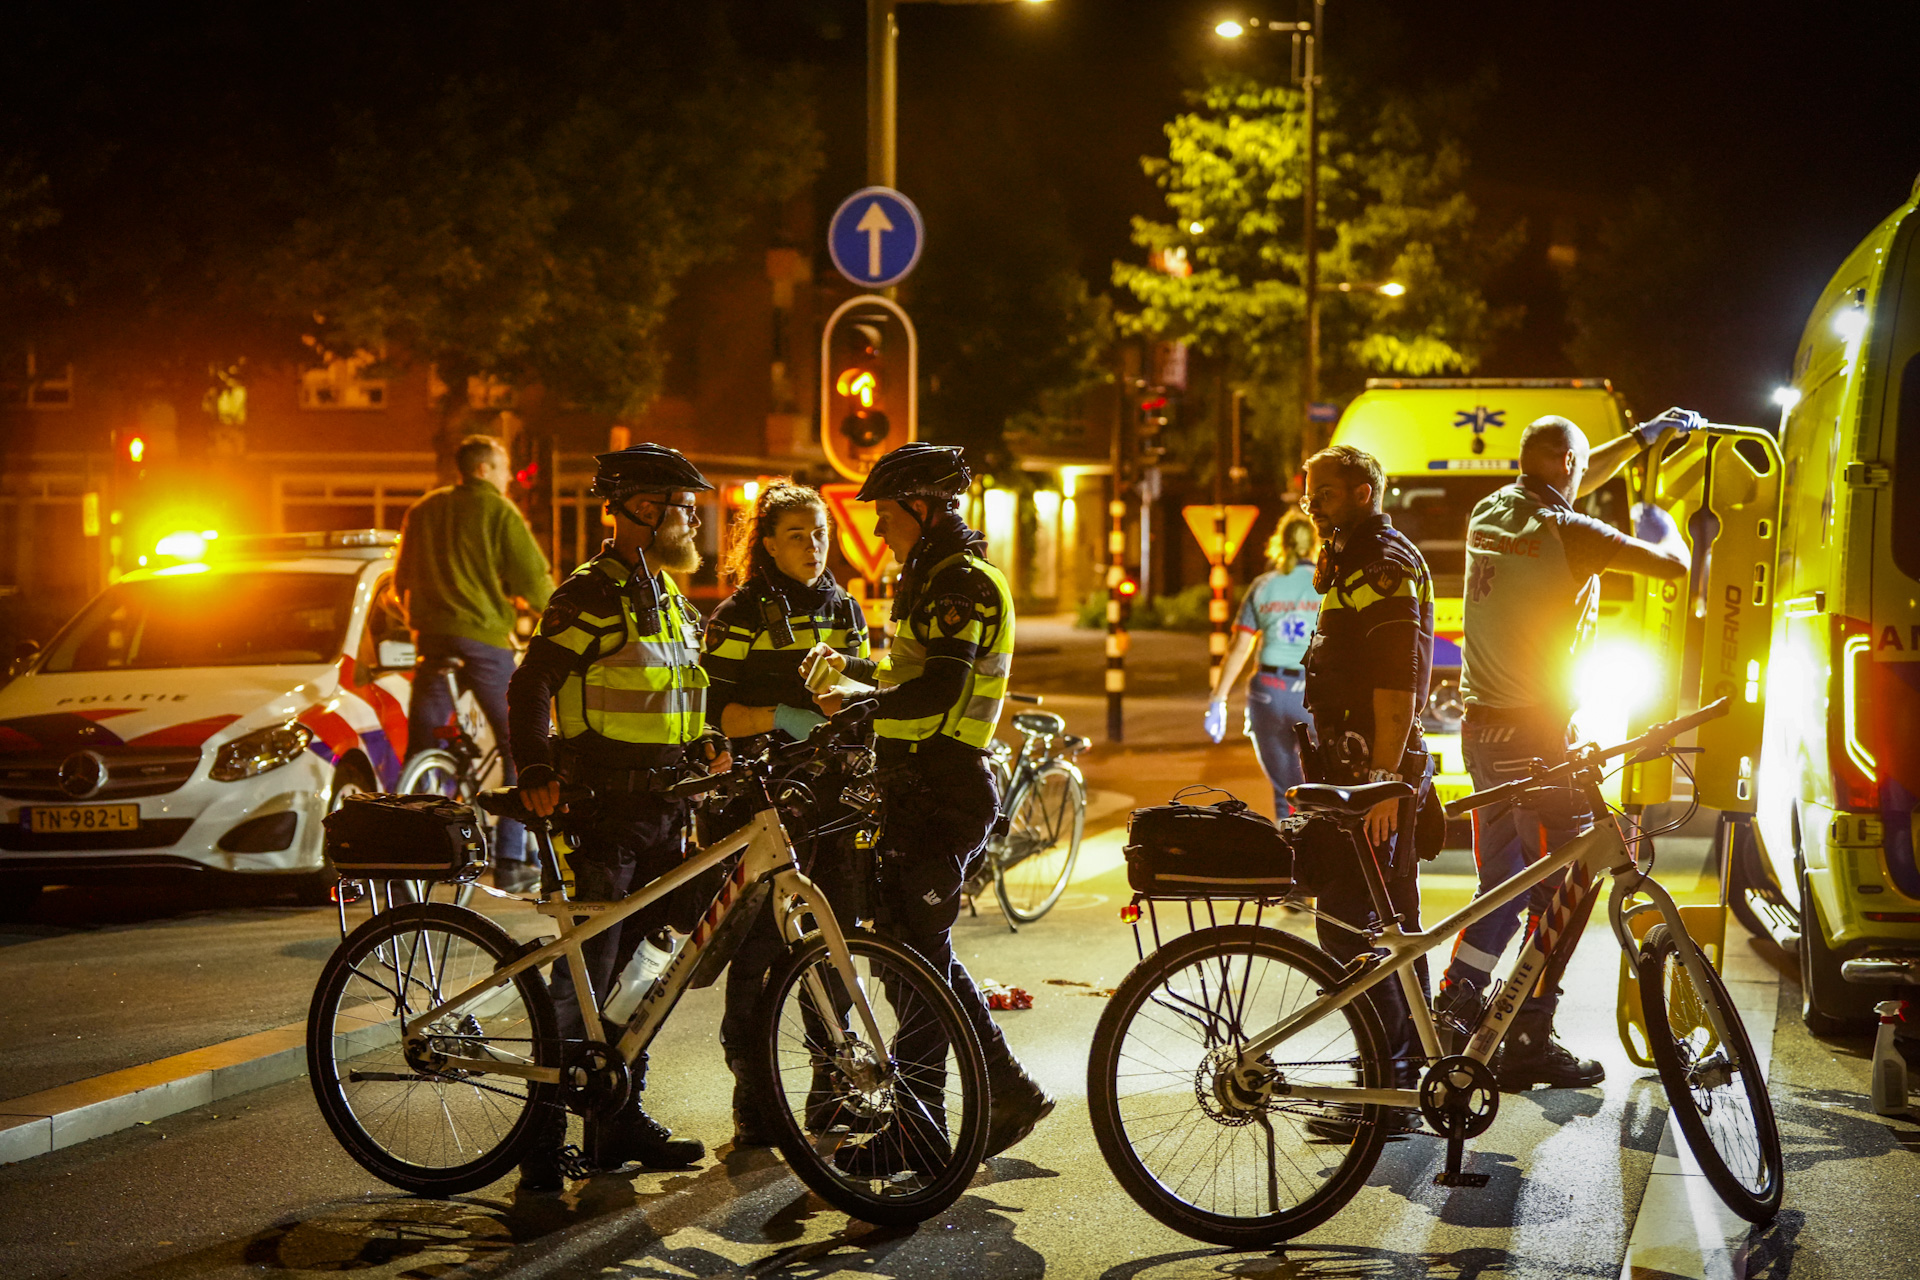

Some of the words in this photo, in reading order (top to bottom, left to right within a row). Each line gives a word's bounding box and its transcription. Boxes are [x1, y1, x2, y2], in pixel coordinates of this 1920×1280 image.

[1721, 585, 1742, 678] FERNO
[56, 694, 187, 706] POLITIE
[36, 809, 129, 829] TN-982-L
[1434, 910, 1472, 938] SANTOS
[1494, 962, 1533, 1021] POLITIE
